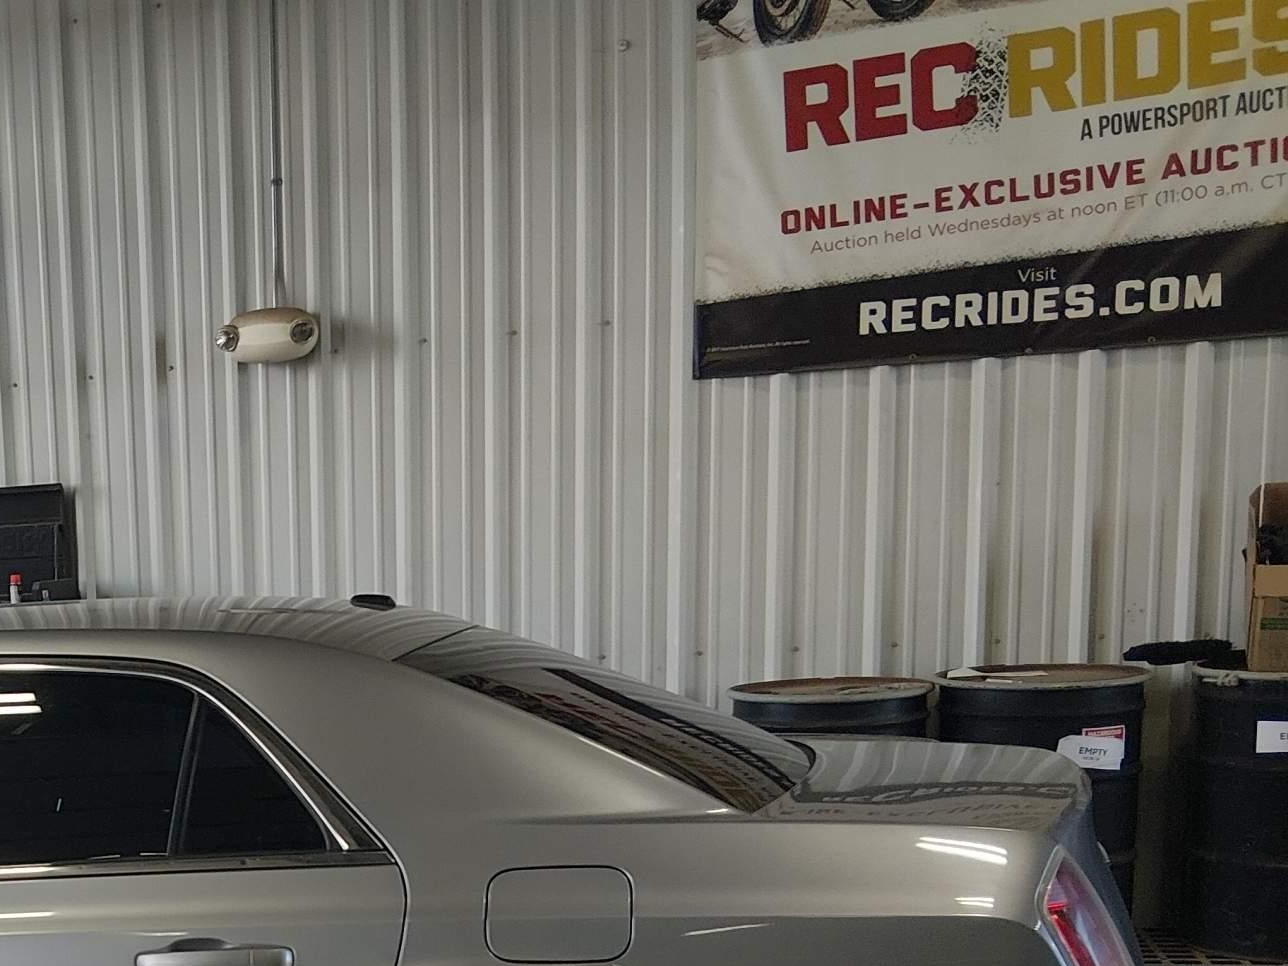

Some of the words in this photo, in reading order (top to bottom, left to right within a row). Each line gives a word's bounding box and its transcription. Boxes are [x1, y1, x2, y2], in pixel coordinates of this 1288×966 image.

[1080, 118, 1093, 141] A
[1098, 95, 1231, 138] POWERSPORT
[780, 158, 1146, 235] ONLINE-EXCLUSIVE
[1160, 134, 1288, 180] AUCTI
[810, 234, 878, 254] Auction
[884, 226, 921, 244] held
[928, 211, 1041, 237] Wednesdays
[1047, 207, 1064, 222] at
[1072, 201, 1118, 217] noon
[1124, 193, 1149, 210] ET
[1155, 184, 1208, 206] (11:00
[1214, 180, 1254, 197] a.m.
[1017, 266, 1057, 283] Visit
[859, 272, 1223, 336] RECRIDES.COM
[1078, 746, 1108, 757] EMPTY
